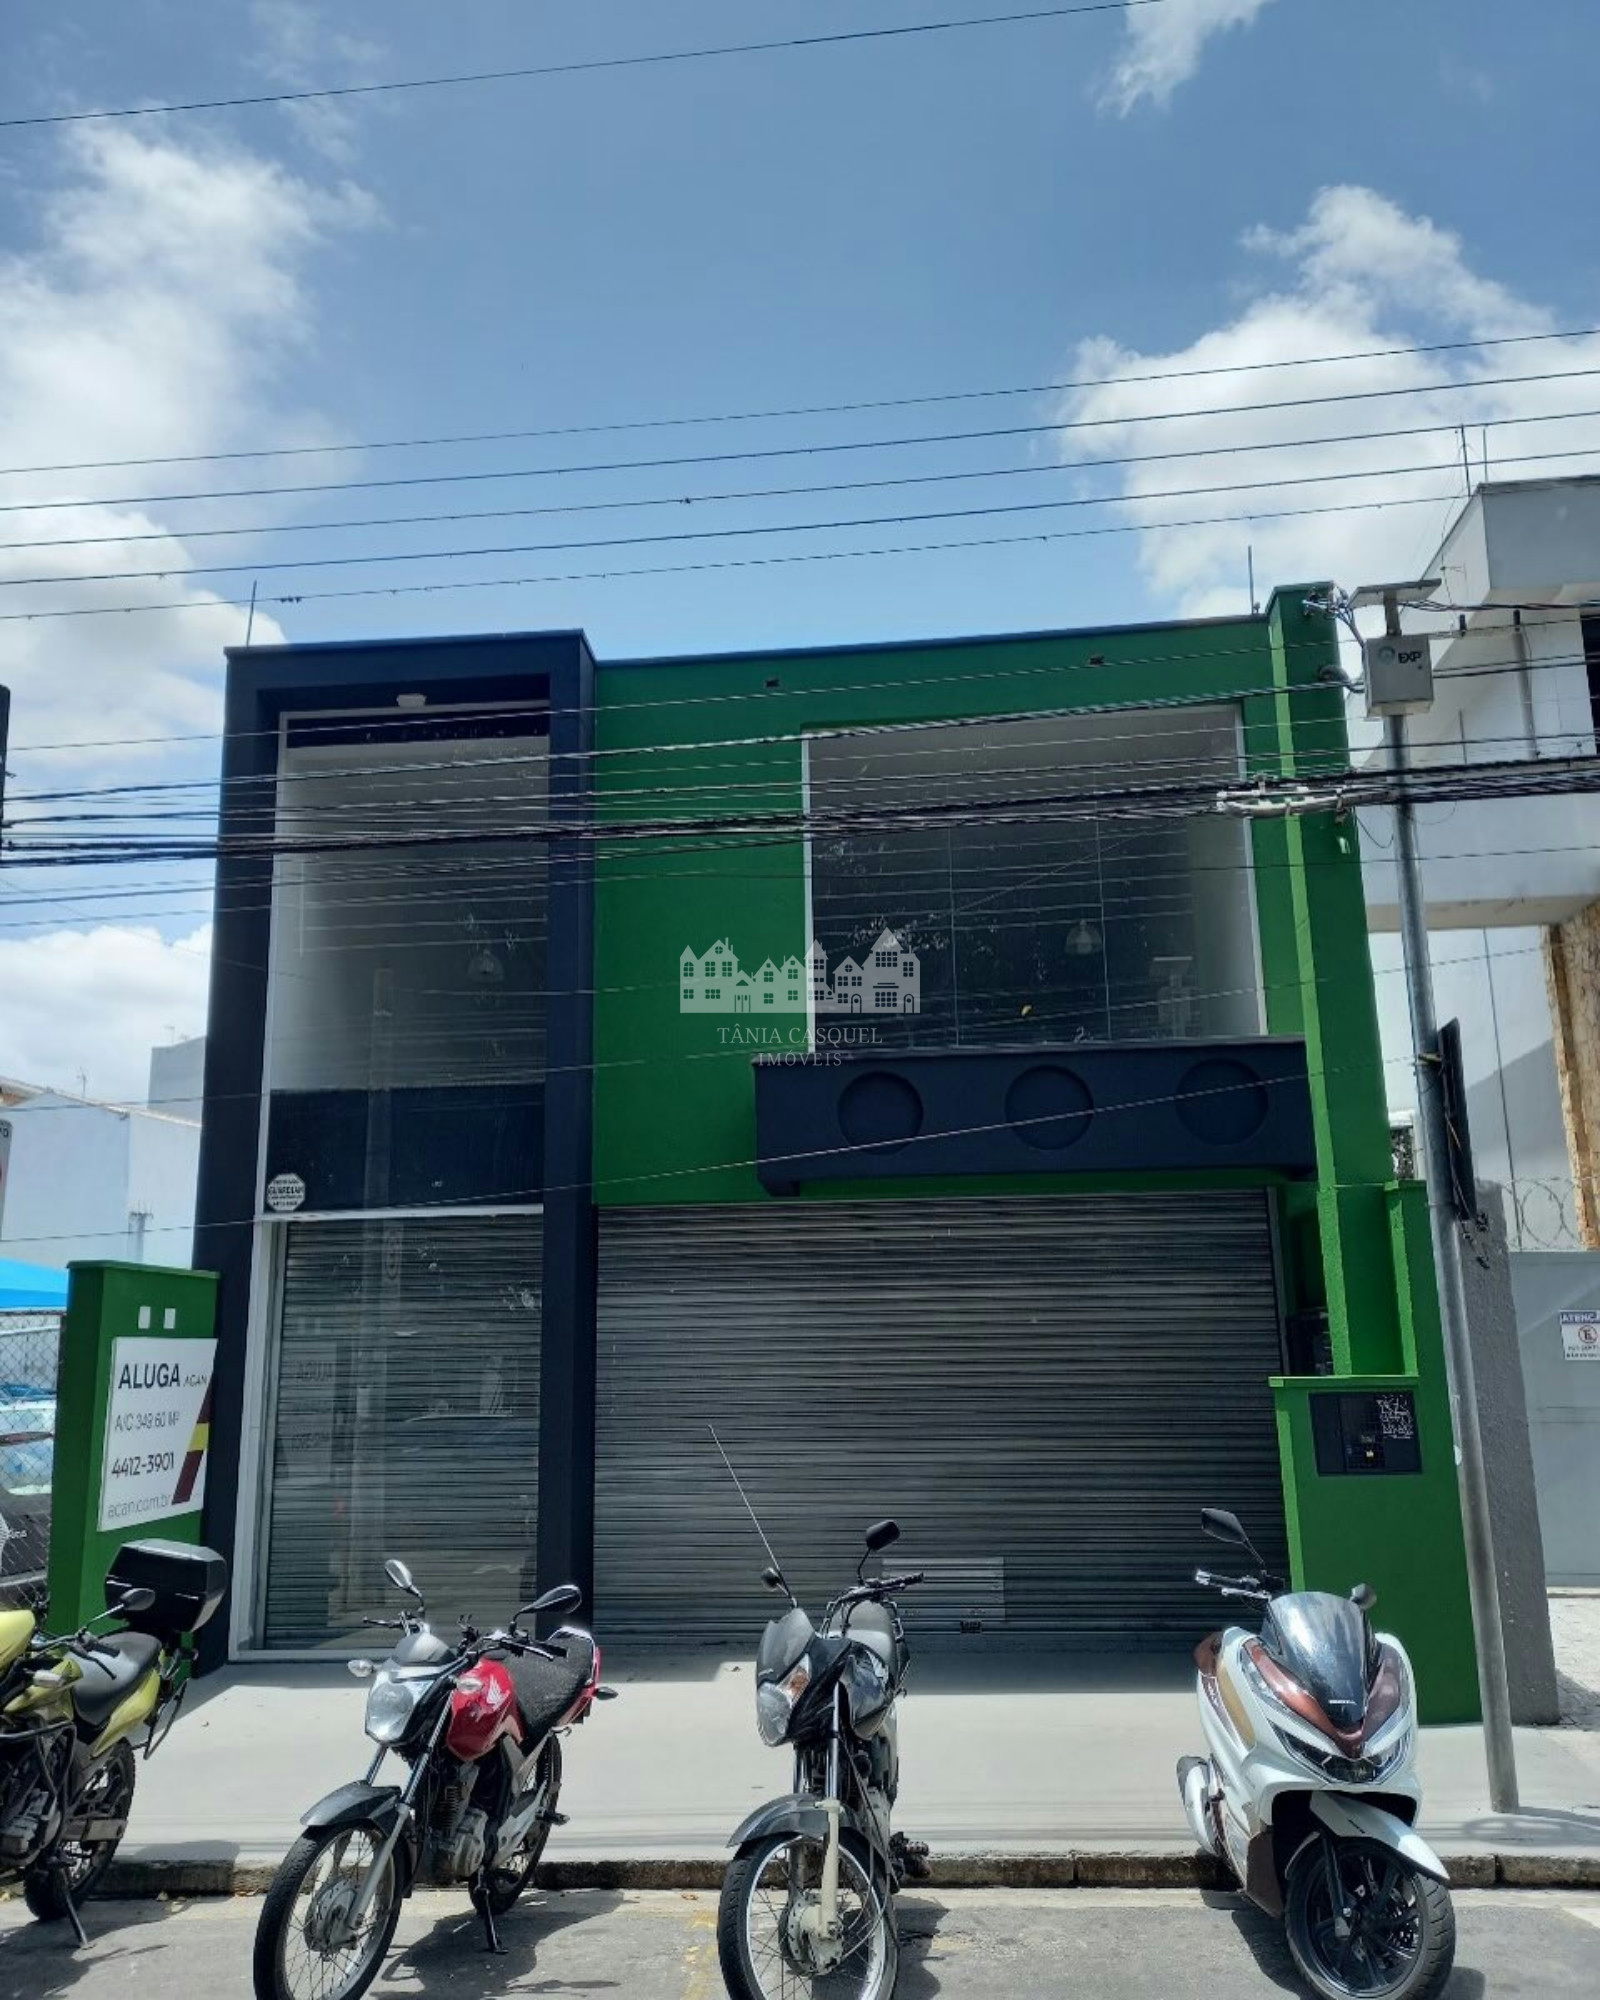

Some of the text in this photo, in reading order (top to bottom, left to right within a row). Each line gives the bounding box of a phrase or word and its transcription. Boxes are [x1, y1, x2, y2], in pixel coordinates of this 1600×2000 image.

[1398, 651, 1422, 664] EXP
[118, 1363, 207, 1389] ALUGA ACAN
[111, 1451, 175, 1479] 4412-3901
[107, 1493, 171, 1518] acan.com.br
